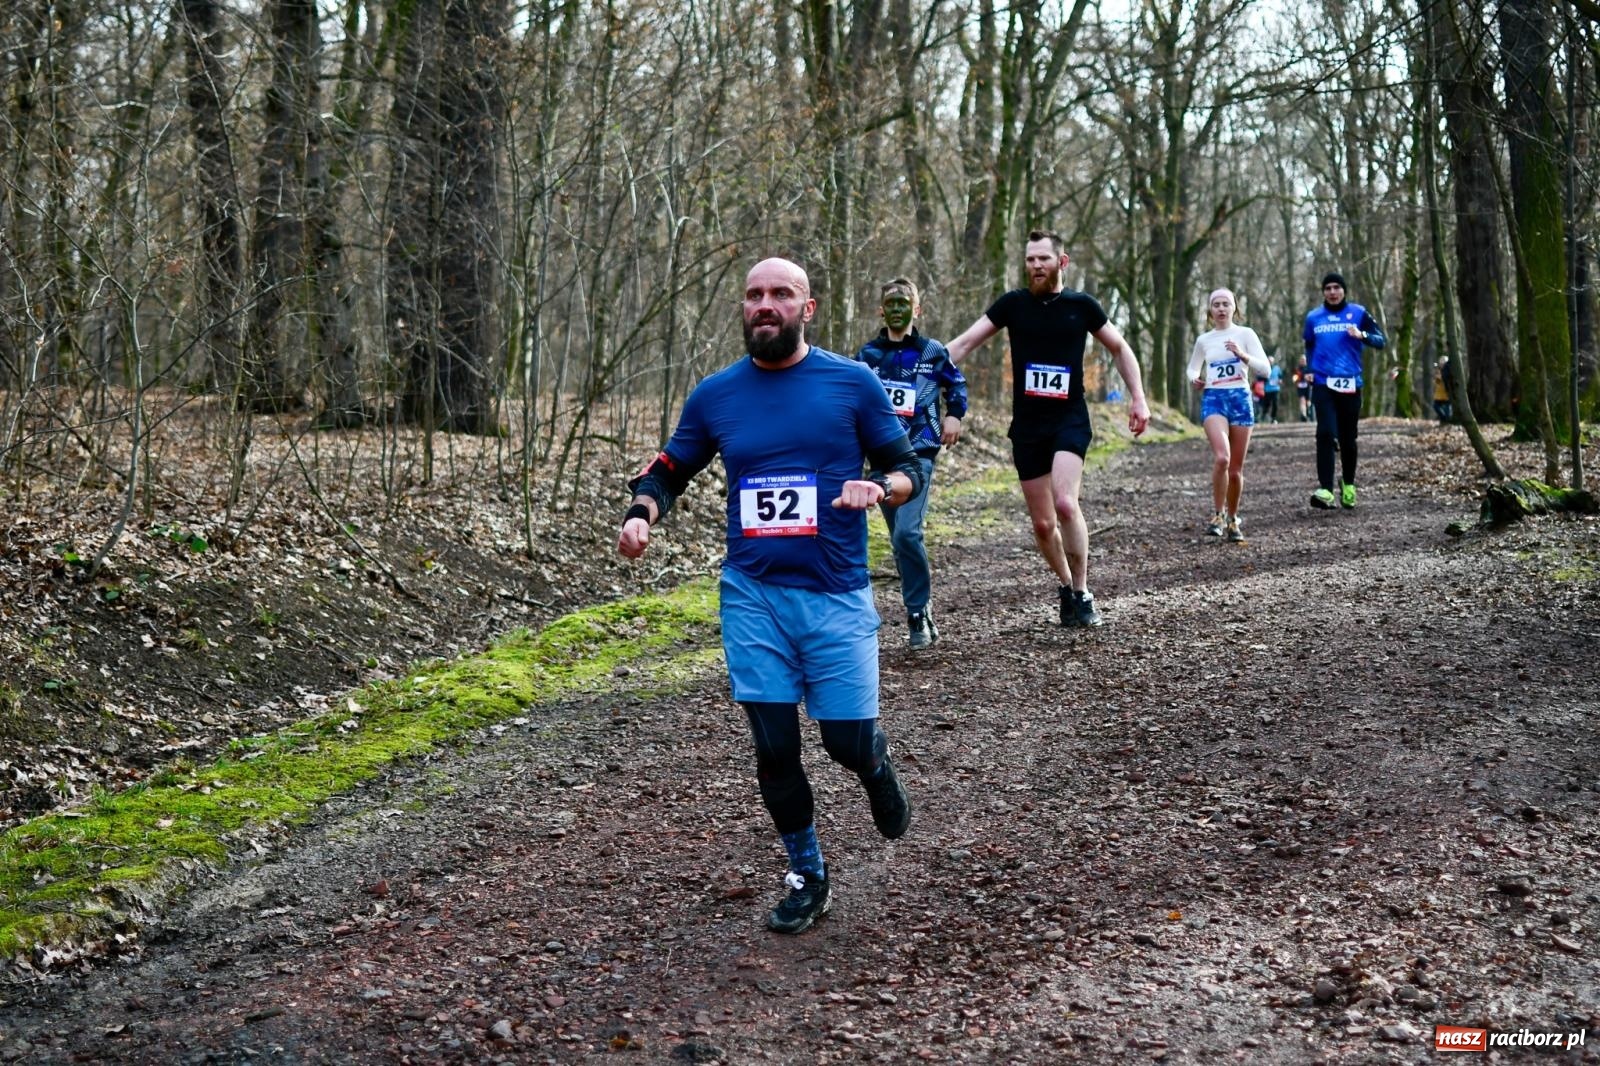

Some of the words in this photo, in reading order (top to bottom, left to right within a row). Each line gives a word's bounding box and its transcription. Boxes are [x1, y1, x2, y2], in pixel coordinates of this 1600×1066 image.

[1217, 364, 1236, 378] 20
[1032, 371, 1063, 390] 114
[1333, 379, 1350, 389] 42
[767, 475, 807, 483] TWARDZIELA
[756, 489, 800, 522] 52
